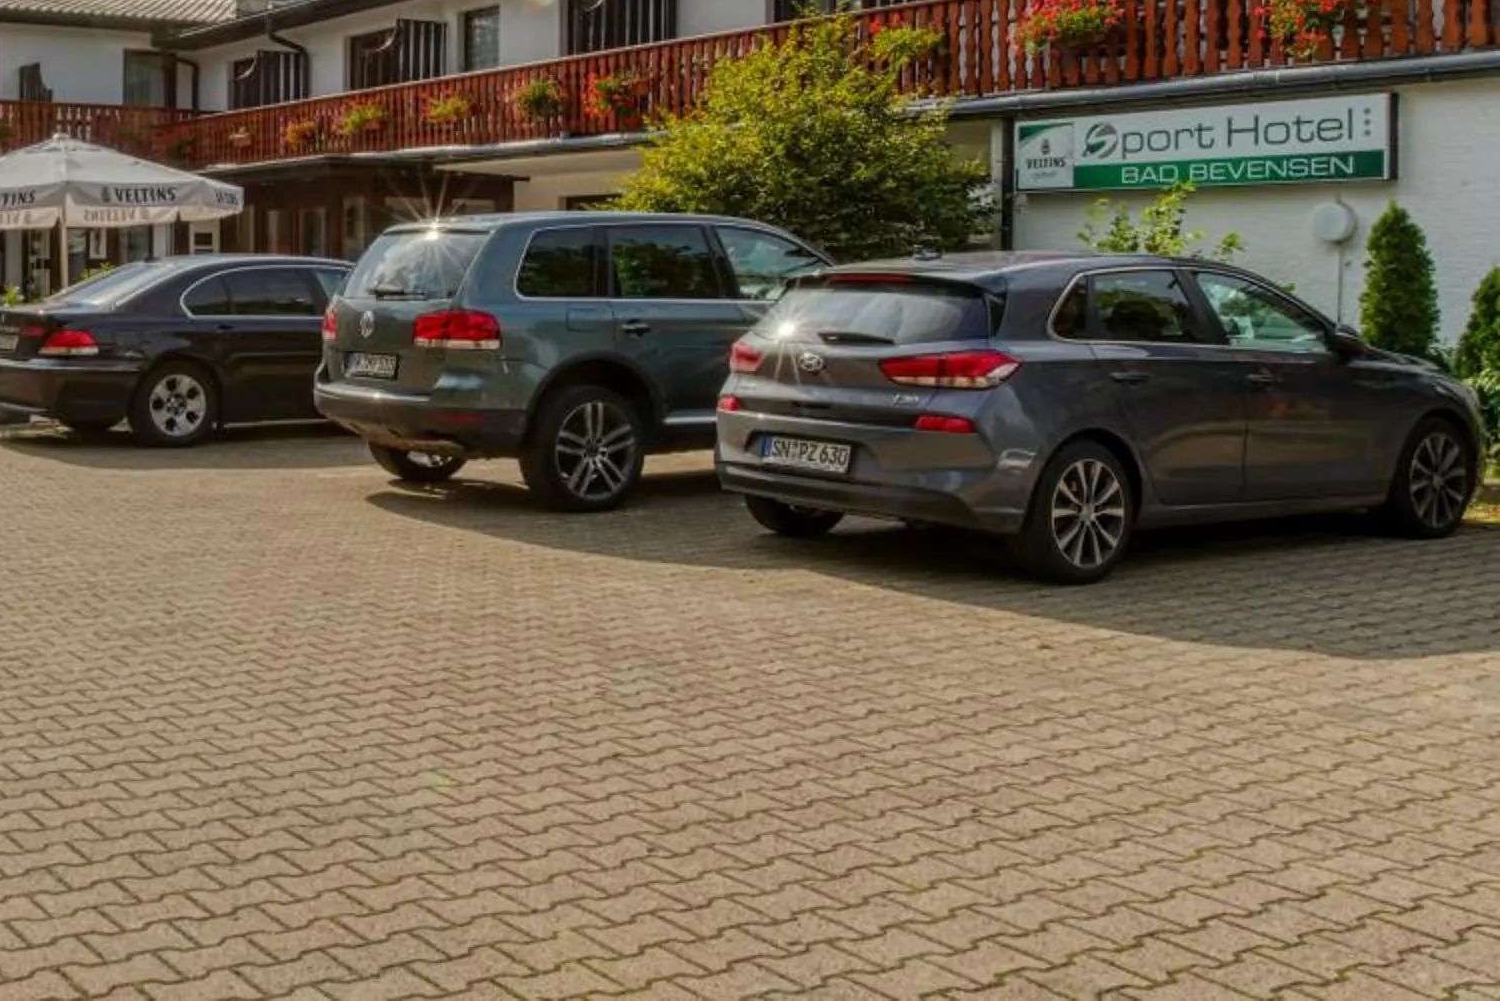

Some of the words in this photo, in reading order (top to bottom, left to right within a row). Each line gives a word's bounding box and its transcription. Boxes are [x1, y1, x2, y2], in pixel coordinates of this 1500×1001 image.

[1227, 108, 1354, 148] Hotel
[1026, 157, 1067, 170] VELTINS
[1121, 166, 1179, 184] BAD
[1190, 154, 1355, 182] BEVENSEN
[115, 187, 176, 202] VELTINS
[773, 440, 791, 458] SN
[800, 442, 818, 462] PZ
